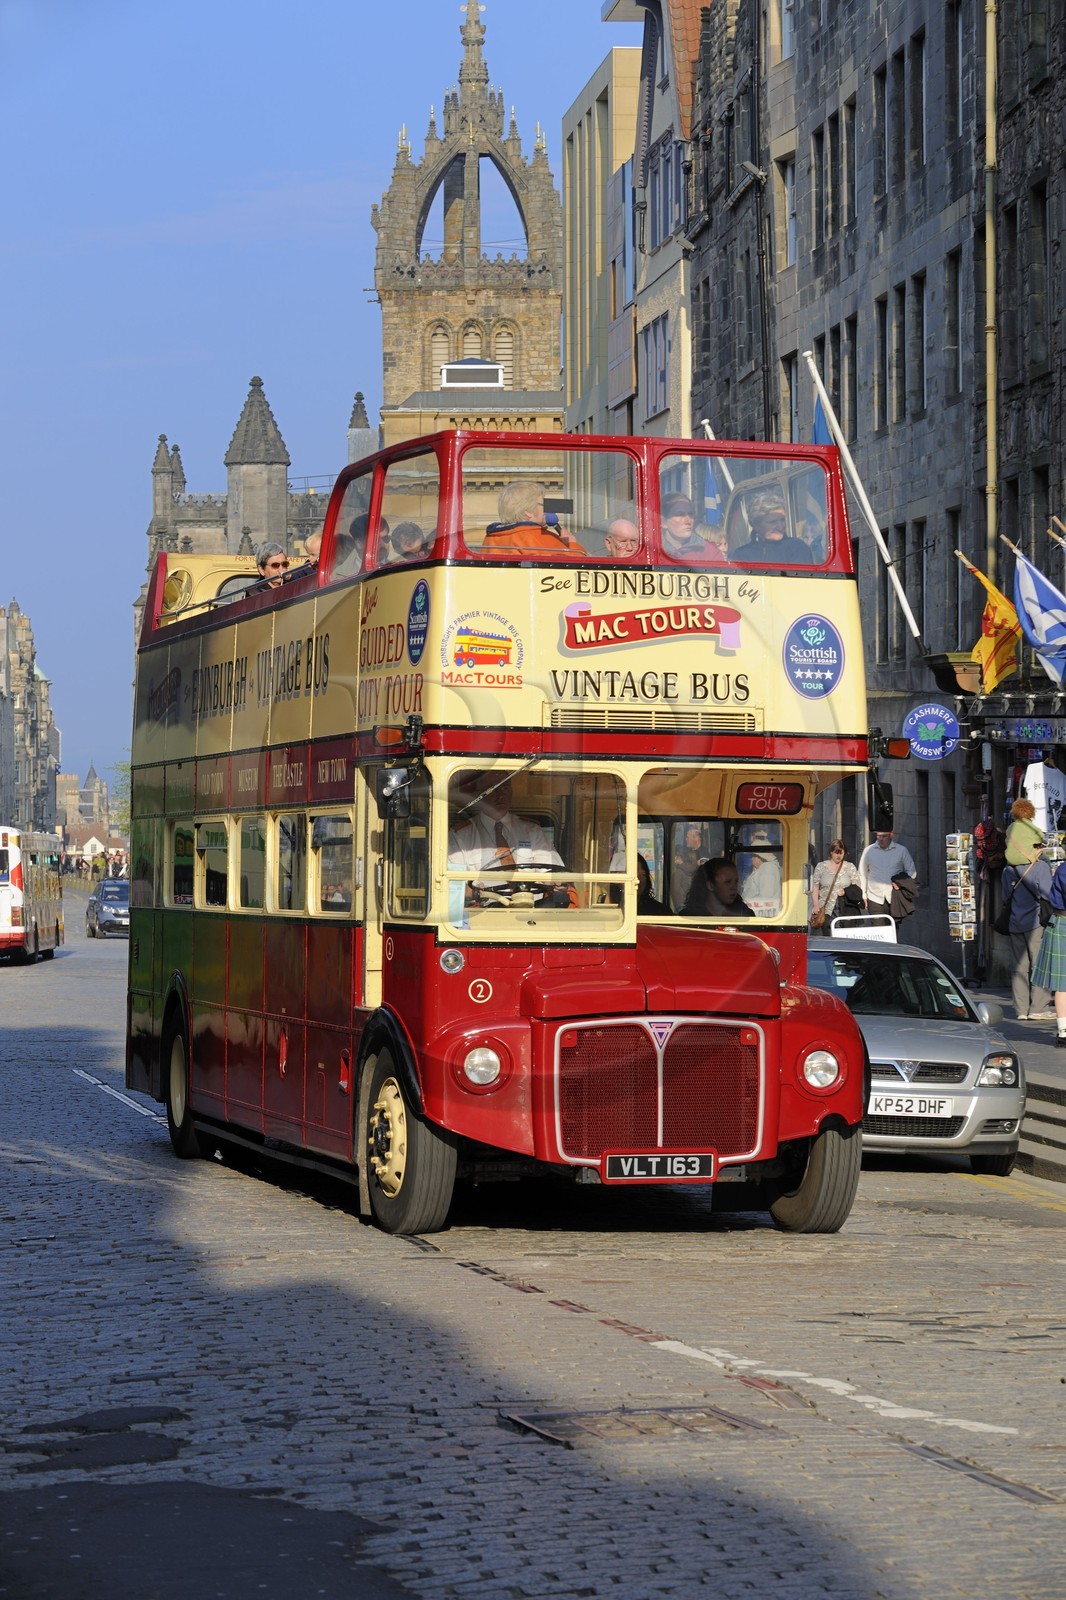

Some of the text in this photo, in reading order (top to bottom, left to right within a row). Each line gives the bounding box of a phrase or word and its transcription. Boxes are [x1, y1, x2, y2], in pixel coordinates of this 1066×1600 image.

[540, 571, 760, 603] See EDINBURGH by
[574, 608, 716, 644] MAC TOURS
[360, 623, 405, 668] GUIDED
[440, 624, 455, 668] EDINBURGH'S
[453, 610, 481, 626] PREMIER
[482, 610, 509, 626] VINTAGE
[508, 624, 519, 638] BUS
[515, 638, 524, 670] COMPANY
[789, 644, 837, 659] Scottish
[192, 656, 248, 714] EDINBURGH
[257, 640, 302, 700] VINTAGE
[305, 633, 330, 690] BUS
[551, 670, 750, 701] VINTAGE BUS
[802, 682, 824, 690] TOUR
[358, 673, 424, 718] CITY TOUR
[908, 707, 954, 725] CASHMERE
[273, 762, 303, 788] THE CASTLE
[318, 758, 347, 783] NEW TOWN
[747, 798, 787, 810] TOUR
[753, 786, 786, 798] CITY
[476, 983, 485, 998] 2
[874, 1097, 947, 1115] KP52 DHF
[620, 1156, 700, 1176] VLT 163
